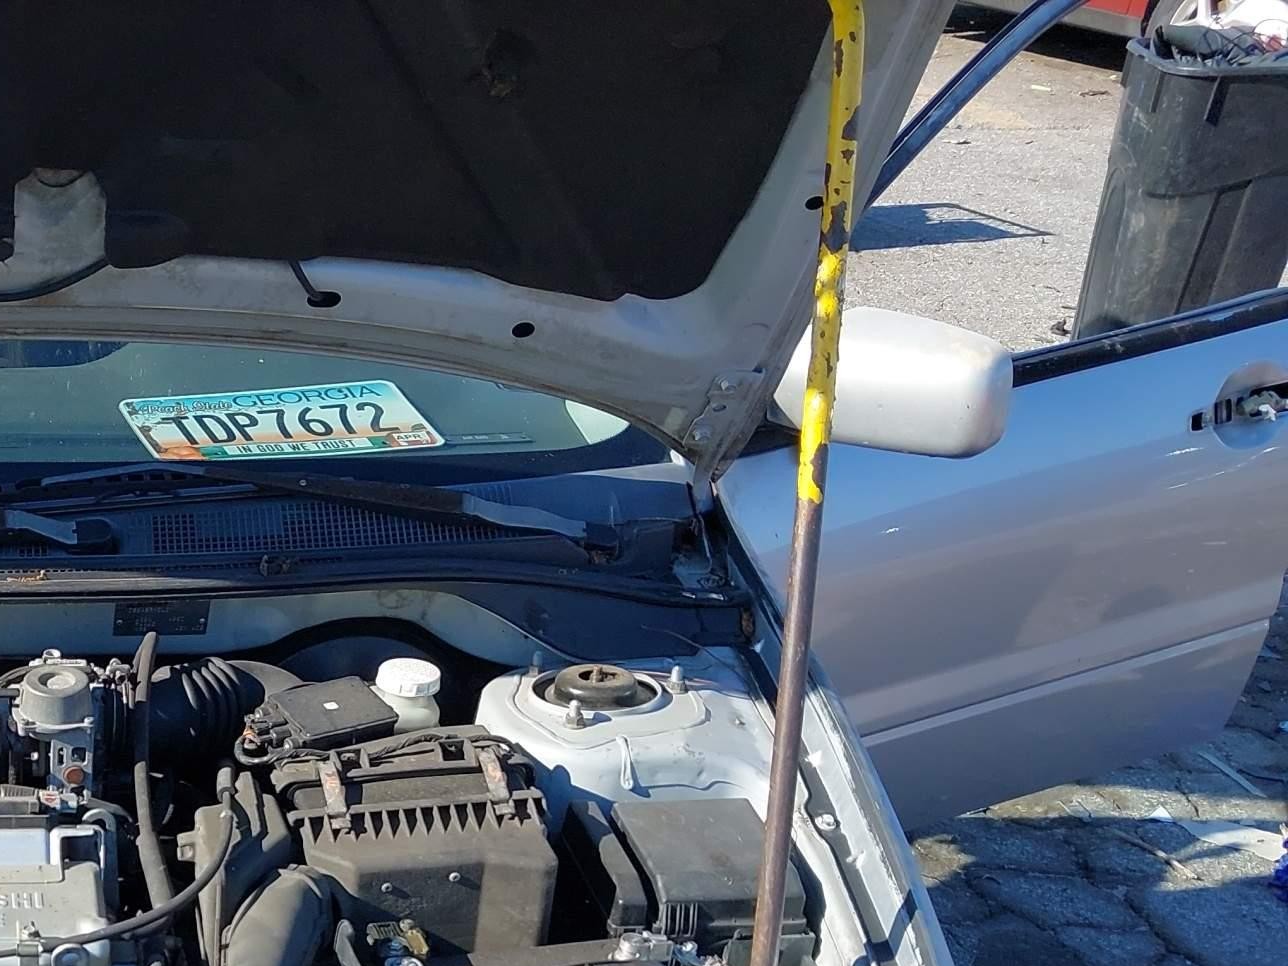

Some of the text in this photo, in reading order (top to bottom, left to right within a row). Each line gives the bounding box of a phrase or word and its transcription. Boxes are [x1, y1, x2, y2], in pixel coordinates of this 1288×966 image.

[232, 385, 383, 408] GEORGIA
[139, 399, 233, 414] Peach State
[160, 401, 400, 445] TDP7672
[236, 439, 357, 454] IN GOD WE TRUST
